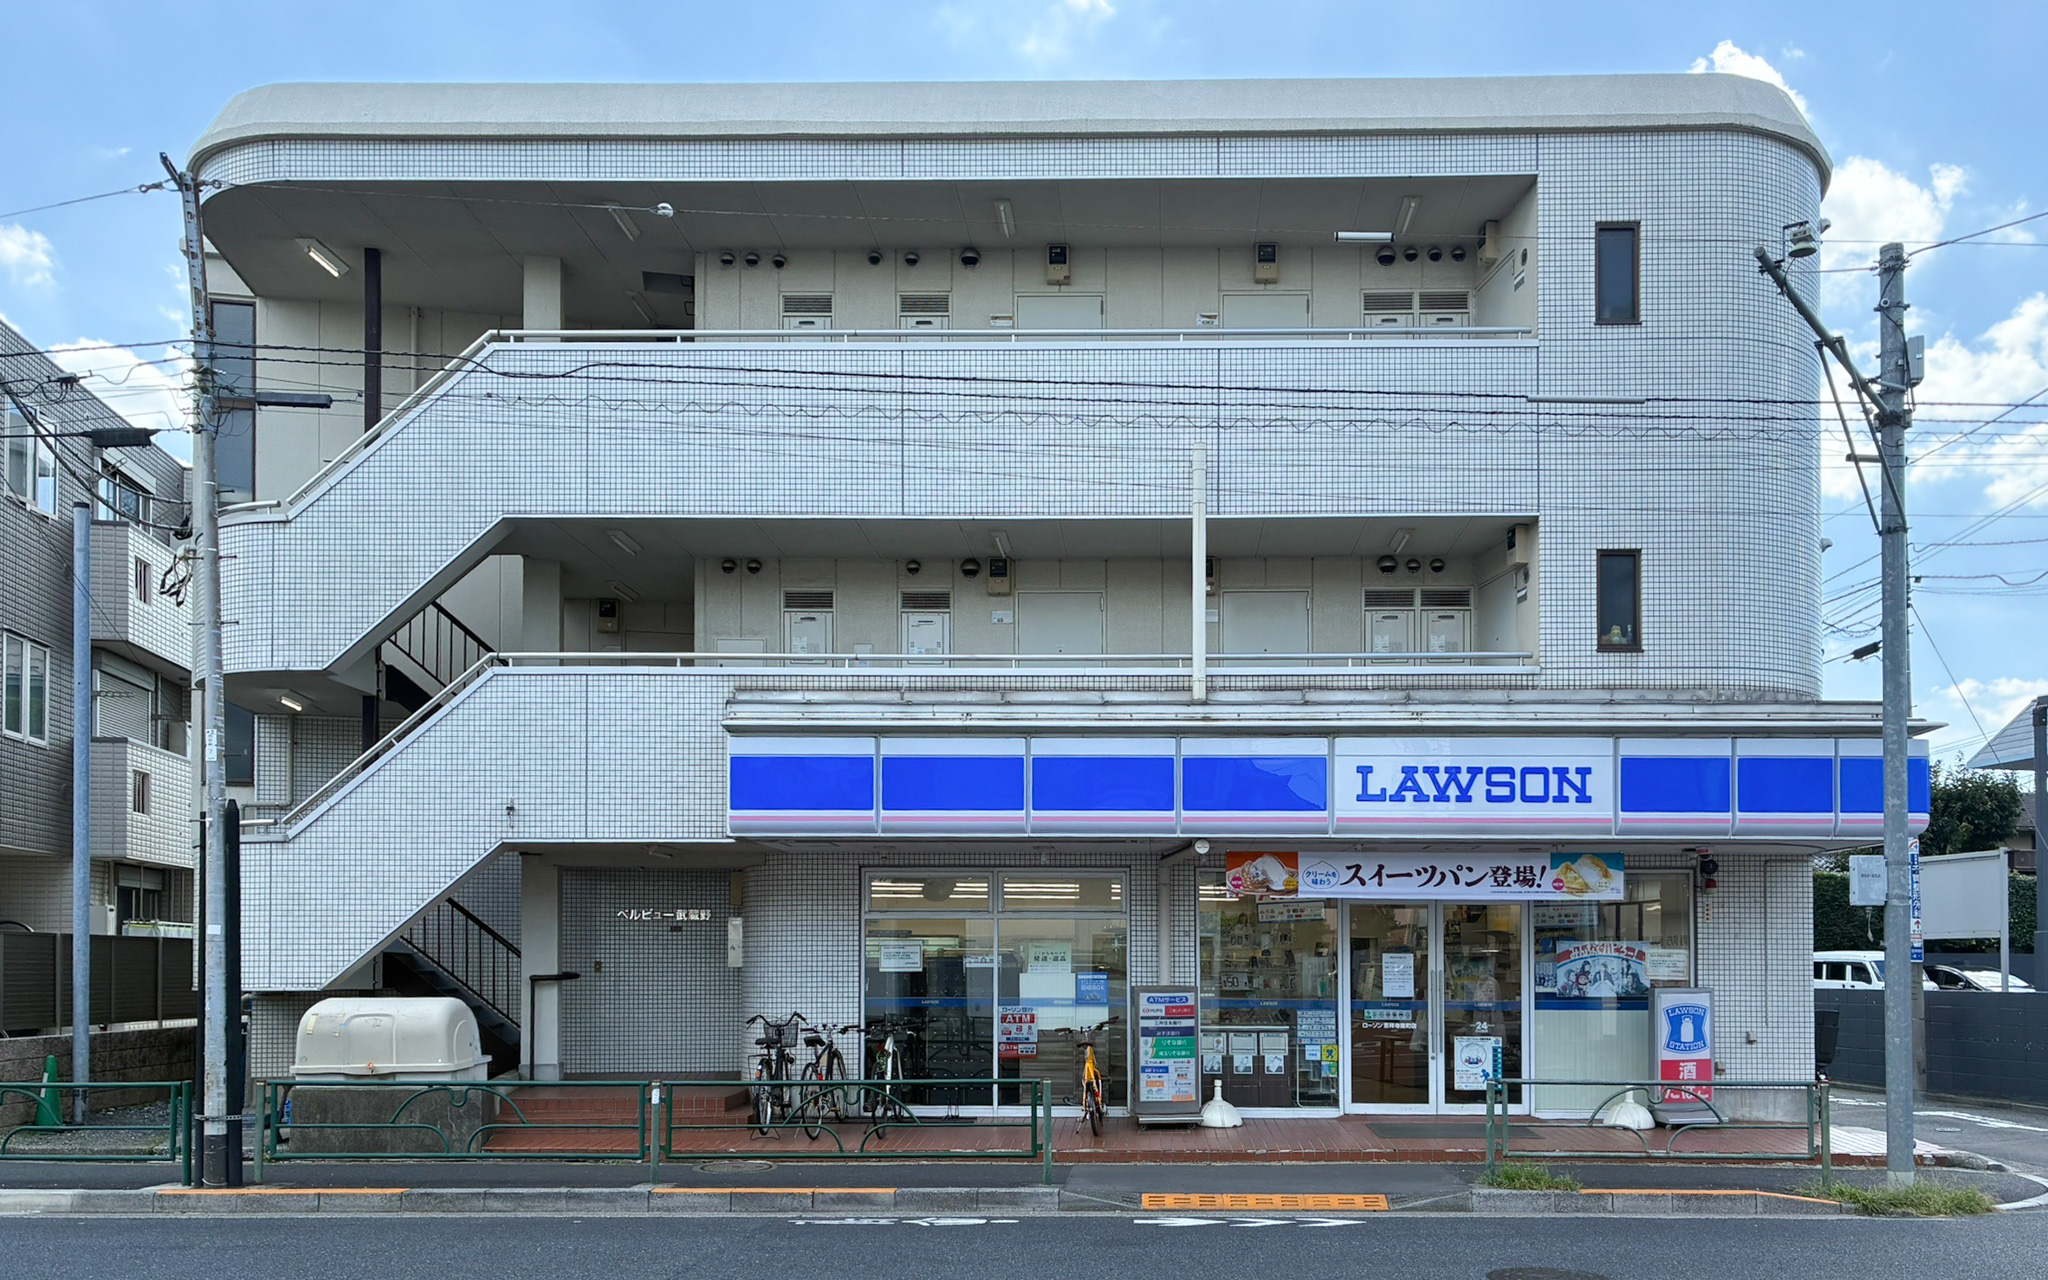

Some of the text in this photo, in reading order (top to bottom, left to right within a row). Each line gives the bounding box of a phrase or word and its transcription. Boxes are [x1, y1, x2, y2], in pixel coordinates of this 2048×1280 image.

[1356, 765, 1592, 803] LAWSON
[1305, 870, 1337, 878] クリームを
[1339, 863, 1547, 888] スイーツパン登場!
[617, 908, 711, 920] ベルビュー武蔵野
[1668, 1006, 1705, 1017] LAWSON
[1006, 1014, 1031, 1023] ATM
[1475, 1021, 1488, 1030] 24
[1669, 1040, 1705, 1051] STATION
[1679, 1062, 1697, 1080] 酒
